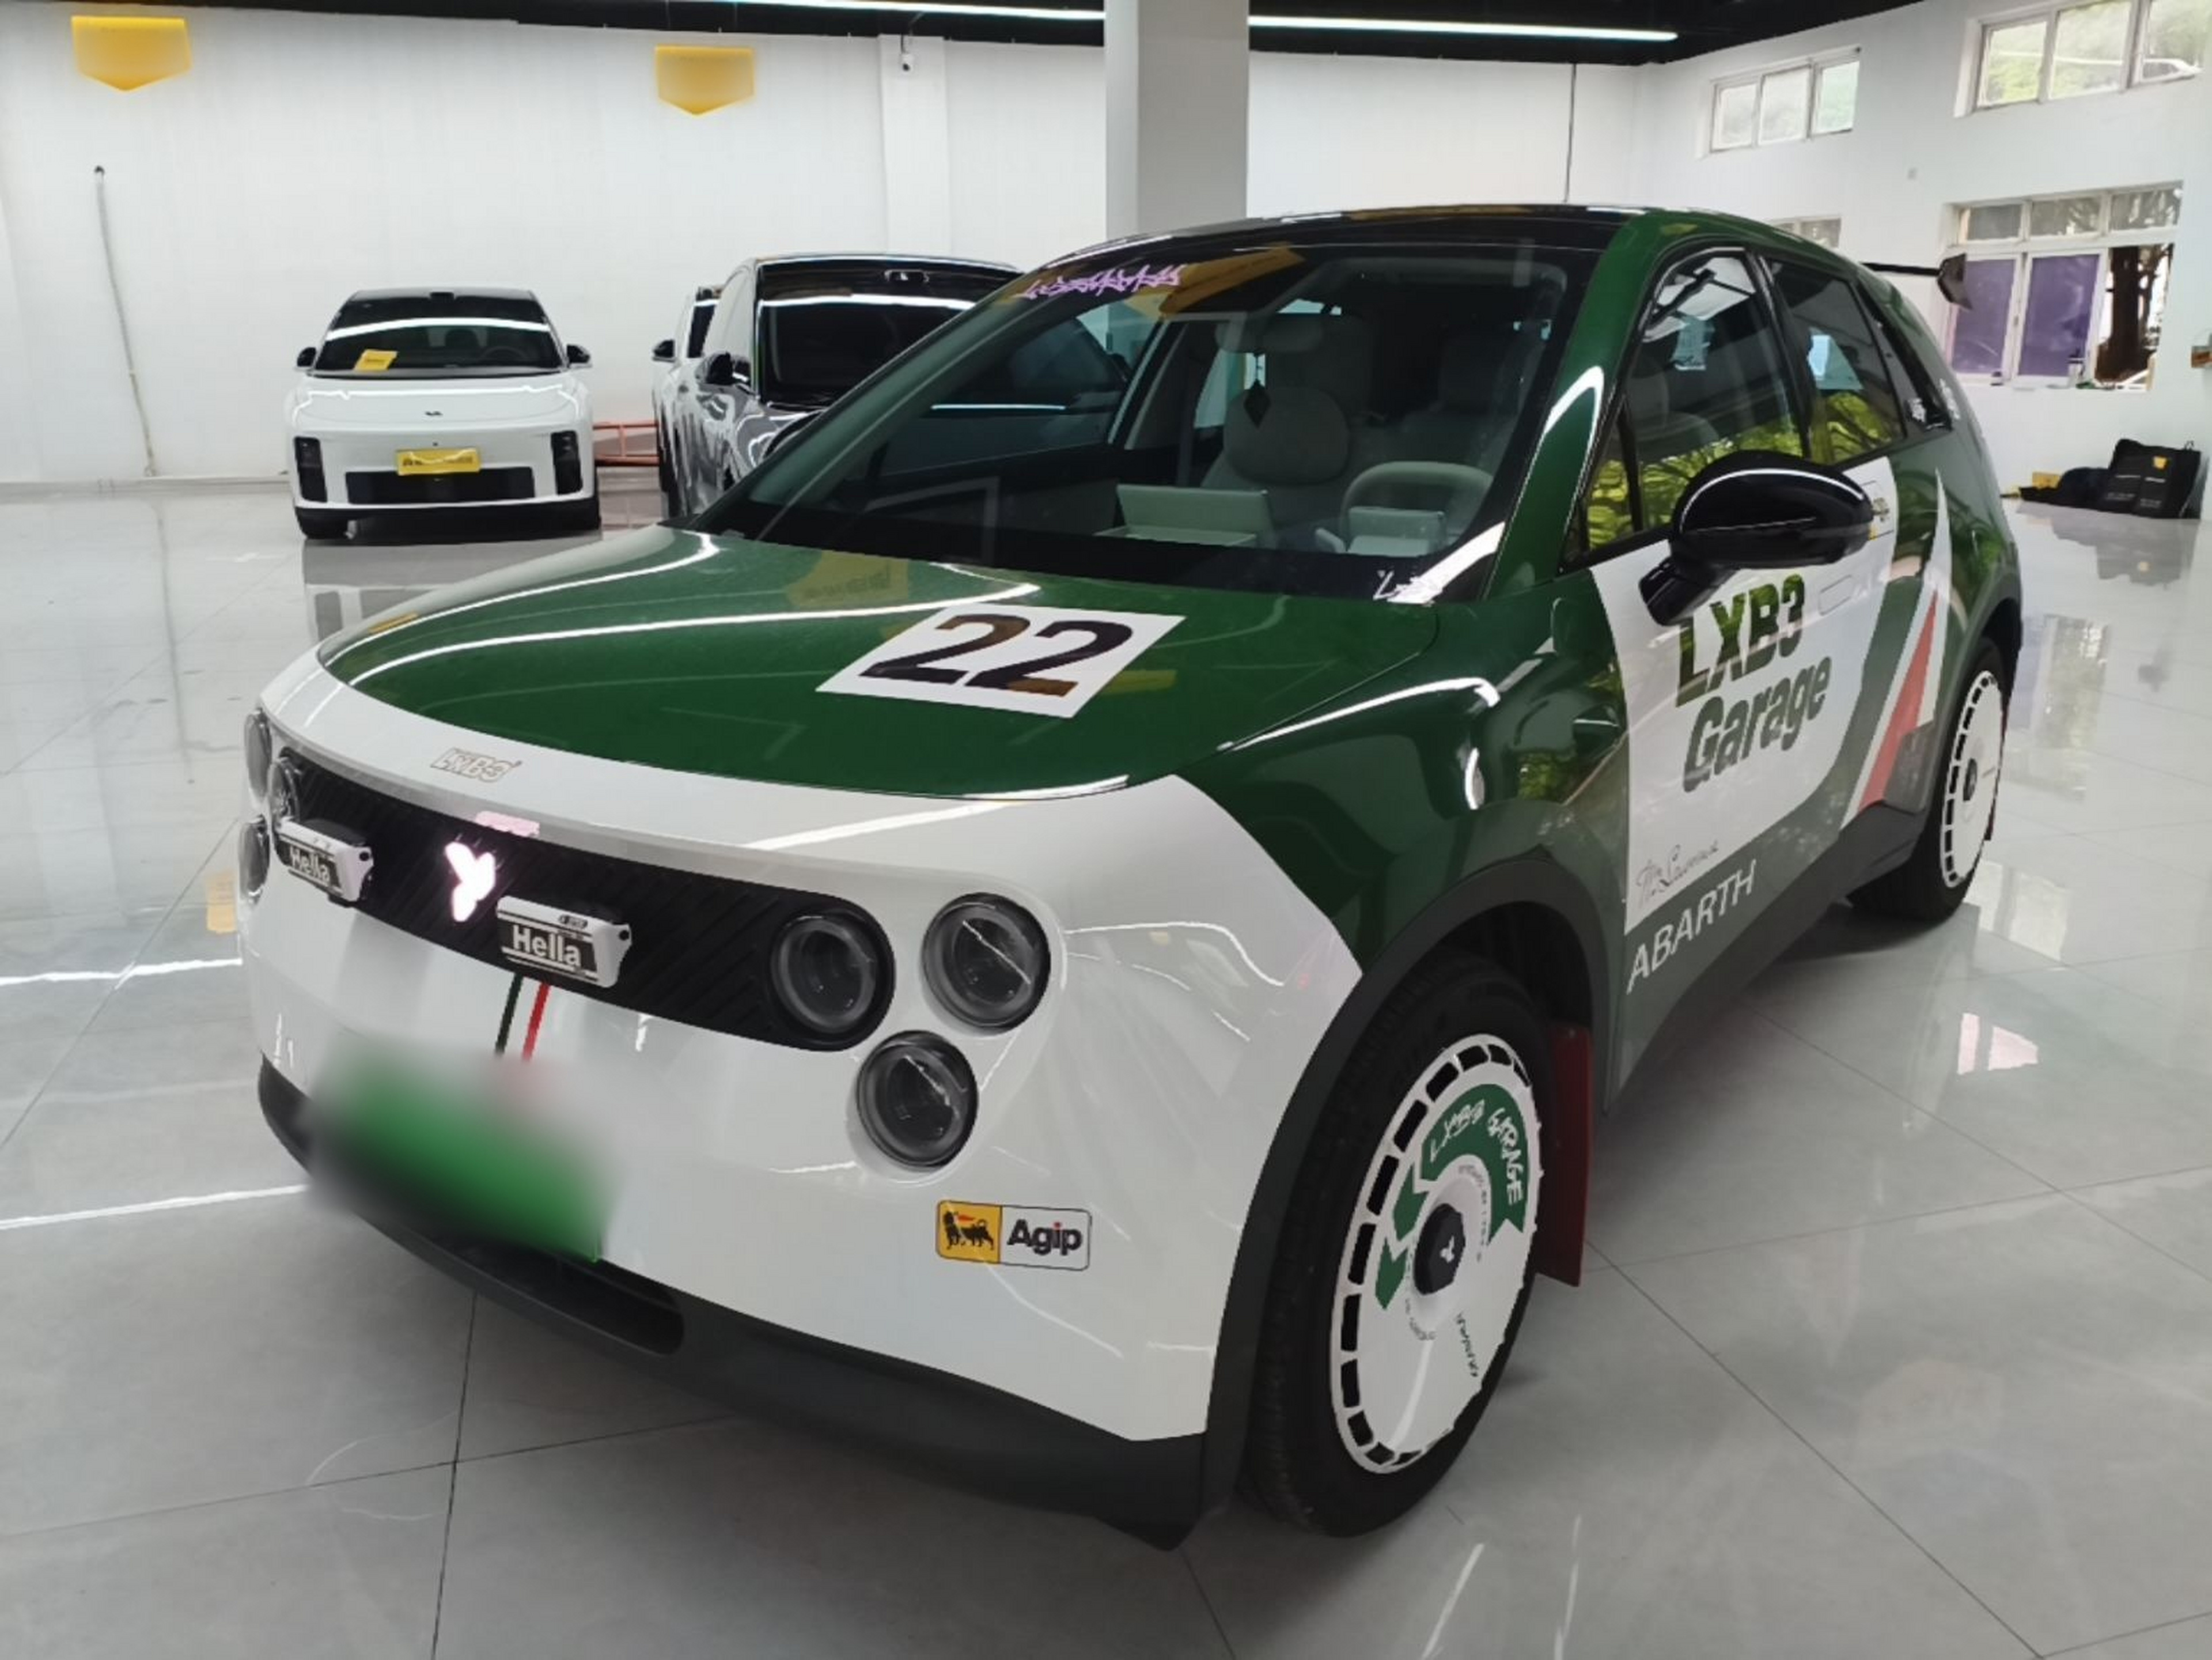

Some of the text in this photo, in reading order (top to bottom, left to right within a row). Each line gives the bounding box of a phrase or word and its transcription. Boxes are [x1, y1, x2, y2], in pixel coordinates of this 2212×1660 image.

[858, 613, 1134, 697] 22
[1676, 573, 1805, 708] LXB3
[1682, 656, 1832, 793] Garage
[290, 844, 331, 884] Hella
[513, 924, 582, 967] Hella
[1626, 859, 1757, 996] ABARTH
[1006, 1219, 1083, 1256] Agip
